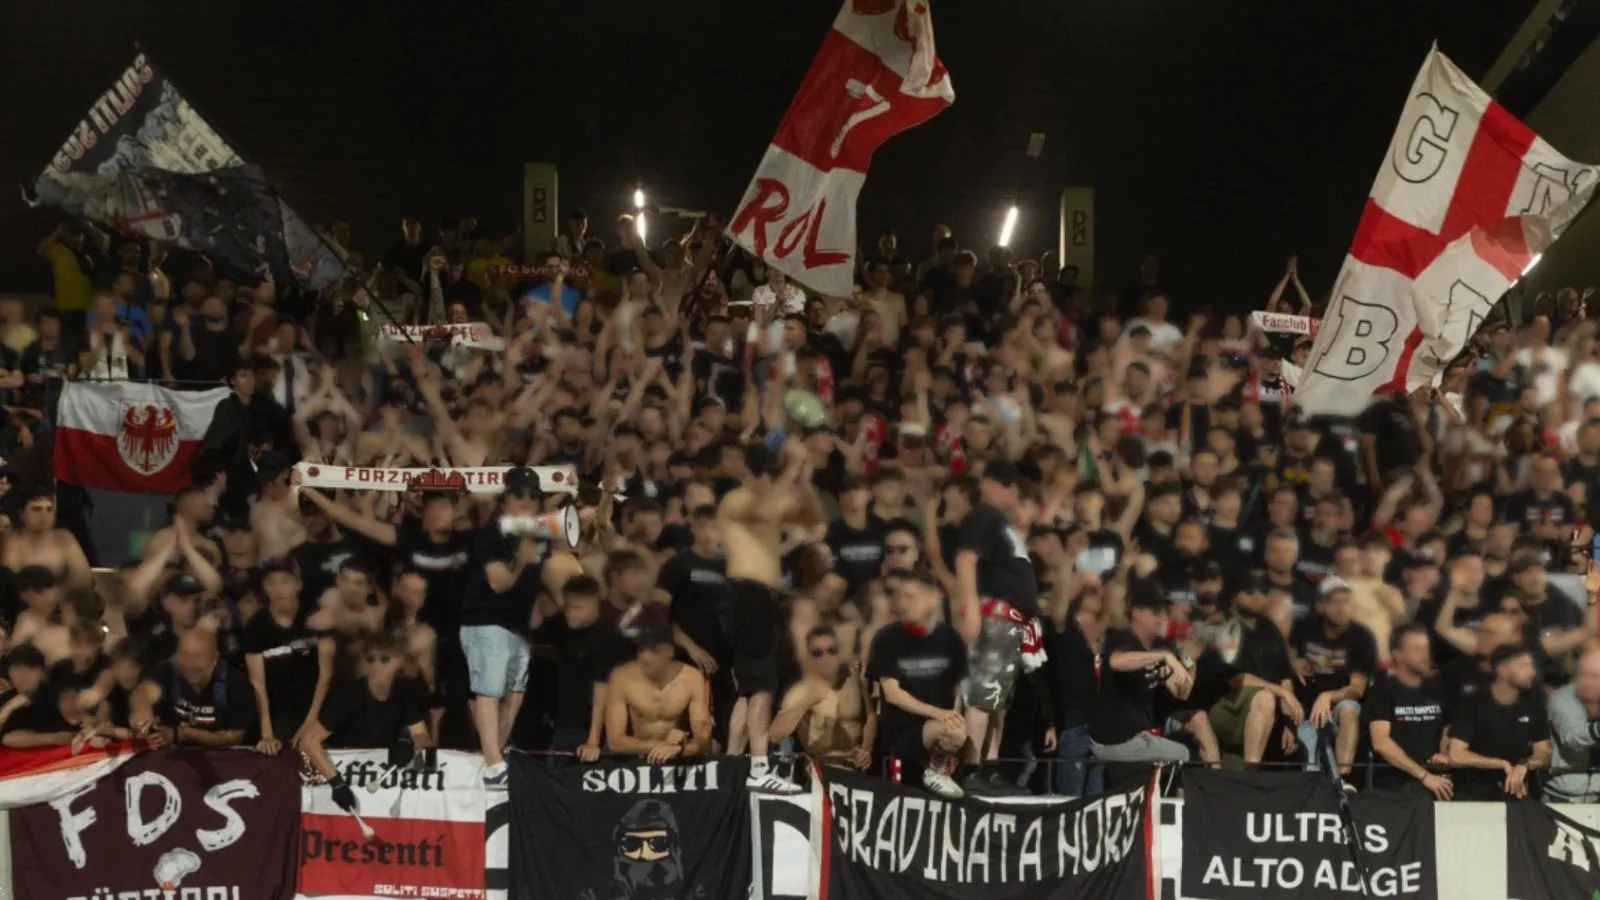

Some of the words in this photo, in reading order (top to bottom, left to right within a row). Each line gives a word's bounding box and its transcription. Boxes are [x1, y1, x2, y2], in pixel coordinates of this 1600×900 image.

[1393, 91, 1459, 183] G
[1262, 314, 1307, 330] Fanclub
[1315, 295, 1399, 380] B
[345, 467, 413, 485] FORZA
[582, 760, 719, 794] SOLITI
[49, 770, 260, 869] FDS
[829, 782, 1042, 883] GRADINATA
[1246, 811, 1389, 853] ULTRS
[300, 828, 446, 867] Presenti
[373, 883, 418, 897] SOLITI
[1202, 855, 1304, 889] ALTO
[1314, 859, 1422, 898] ADGE
